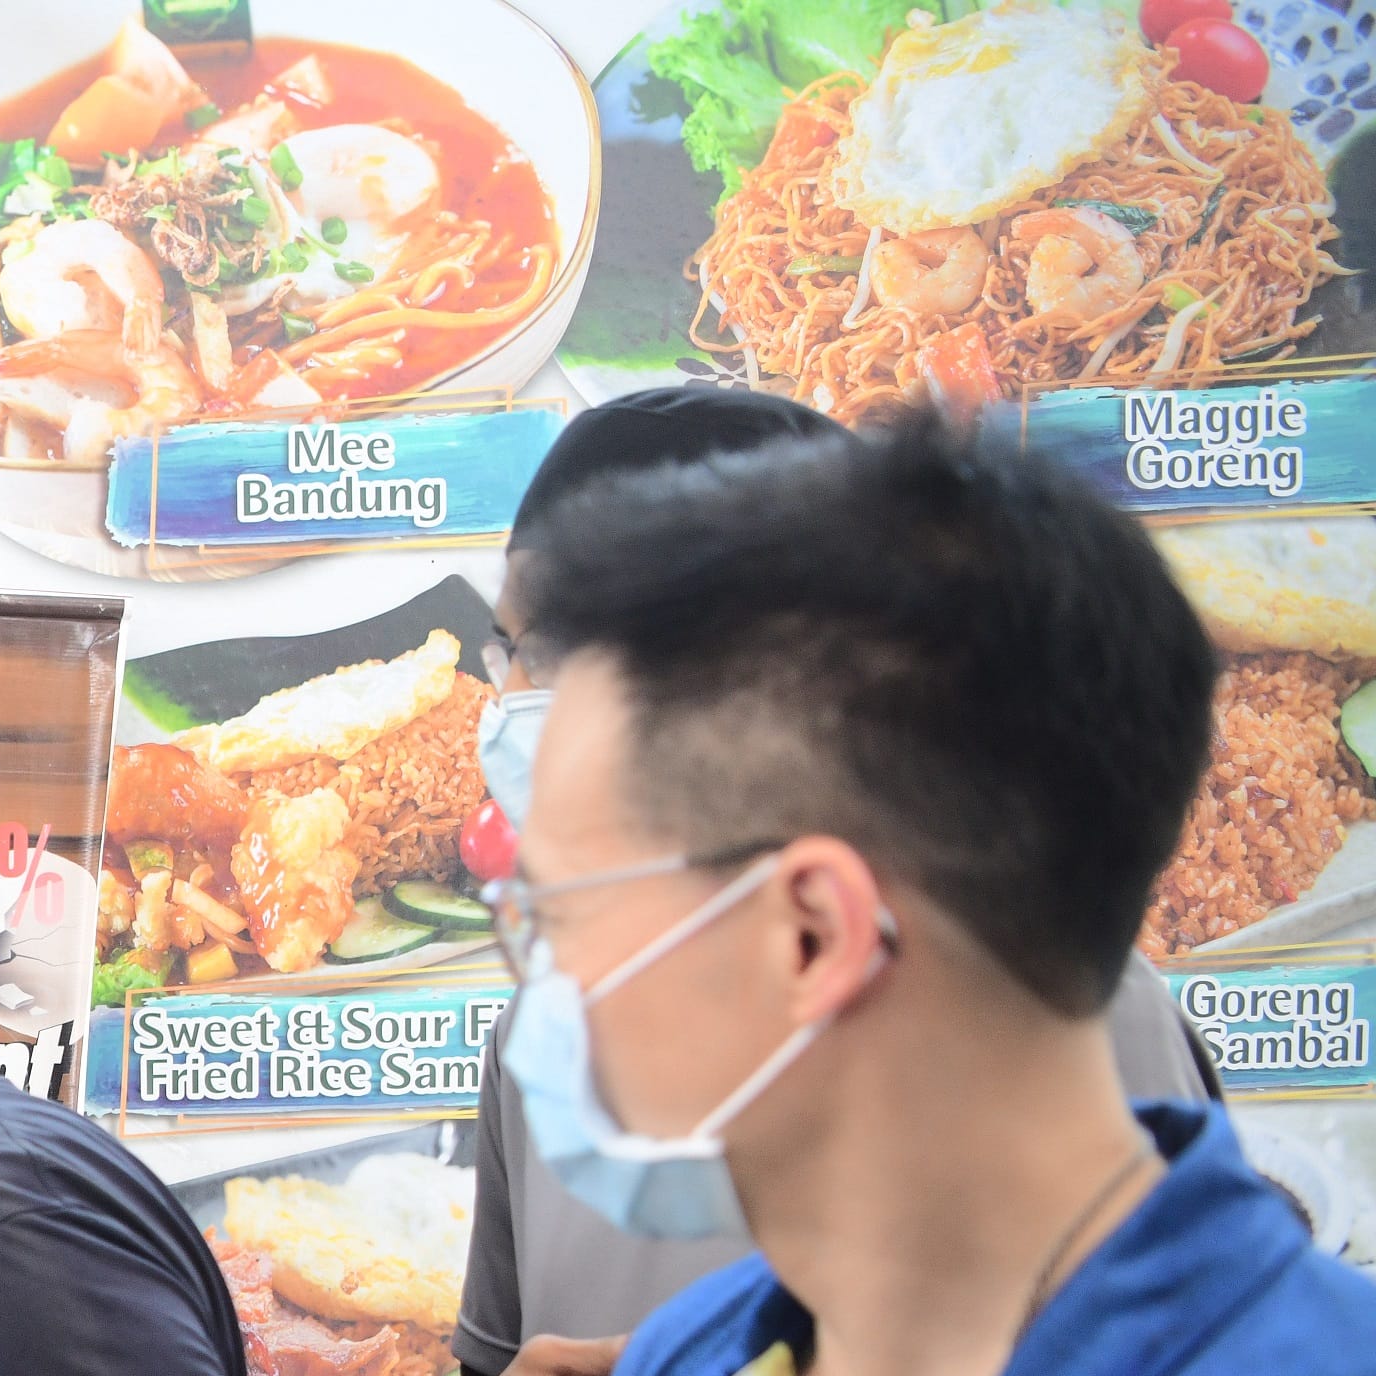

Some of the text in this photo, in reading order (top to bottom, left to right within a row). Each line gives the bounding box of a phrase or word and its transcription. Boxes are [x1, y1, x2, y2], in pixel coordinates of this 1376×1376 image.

[1130, 393, 1303, 444] Maggie
[293, 429, 391, 468] Mee
[1132, 444, 1298, 491] Goreng
[242, 477, 442, 522] Bandung
[1186, 980, 1350, 1026] Goreng
[139, 1011, 275, 1050] Sweet
[292, 1009, 330, 1047] &
[347, 1005, 450, 1046] Sour
[145, 1055, 254, 1095] Fried
[275, 1055, 366, 1092] Rice
